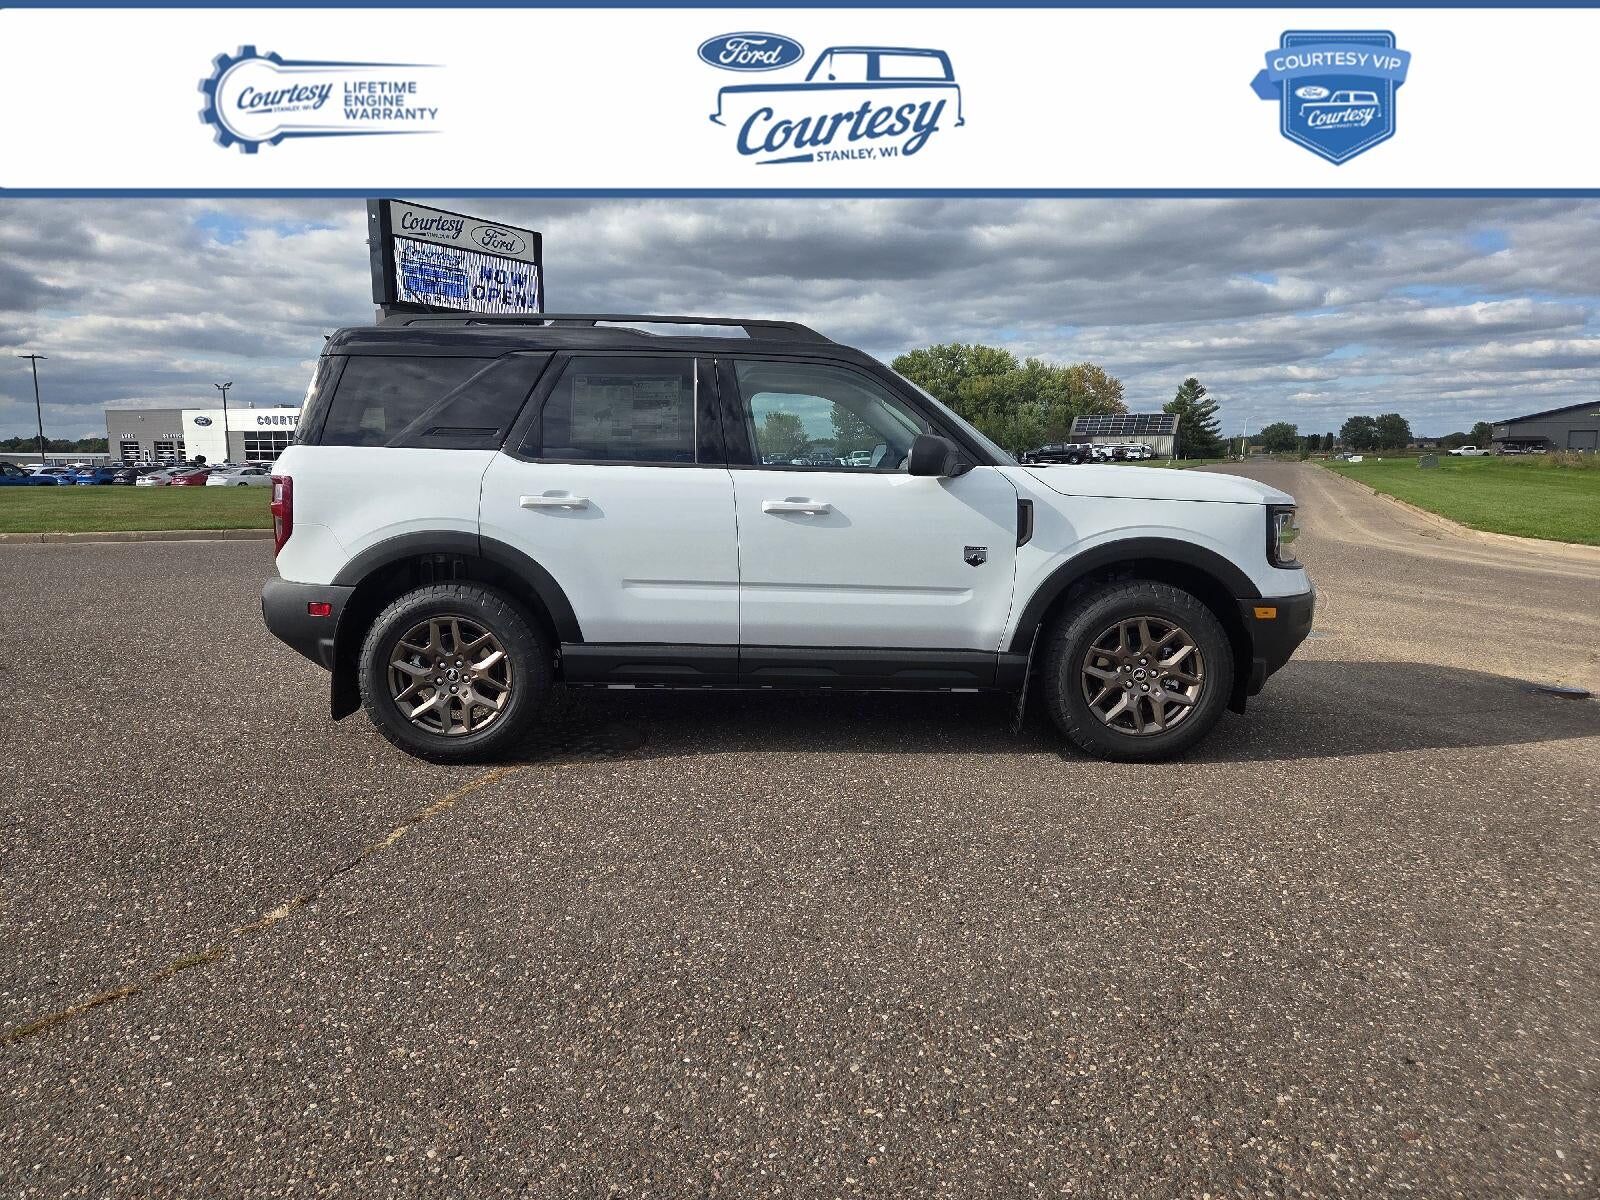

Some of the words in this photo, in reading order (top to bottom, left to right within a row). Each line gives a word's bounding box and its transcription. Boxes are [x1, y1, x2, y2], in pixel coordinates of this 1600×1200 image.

[401, 211, 464, 239] Courtesy
[482, 228, 516, 252] Ford
[480, 266, 527, 287] NOW
